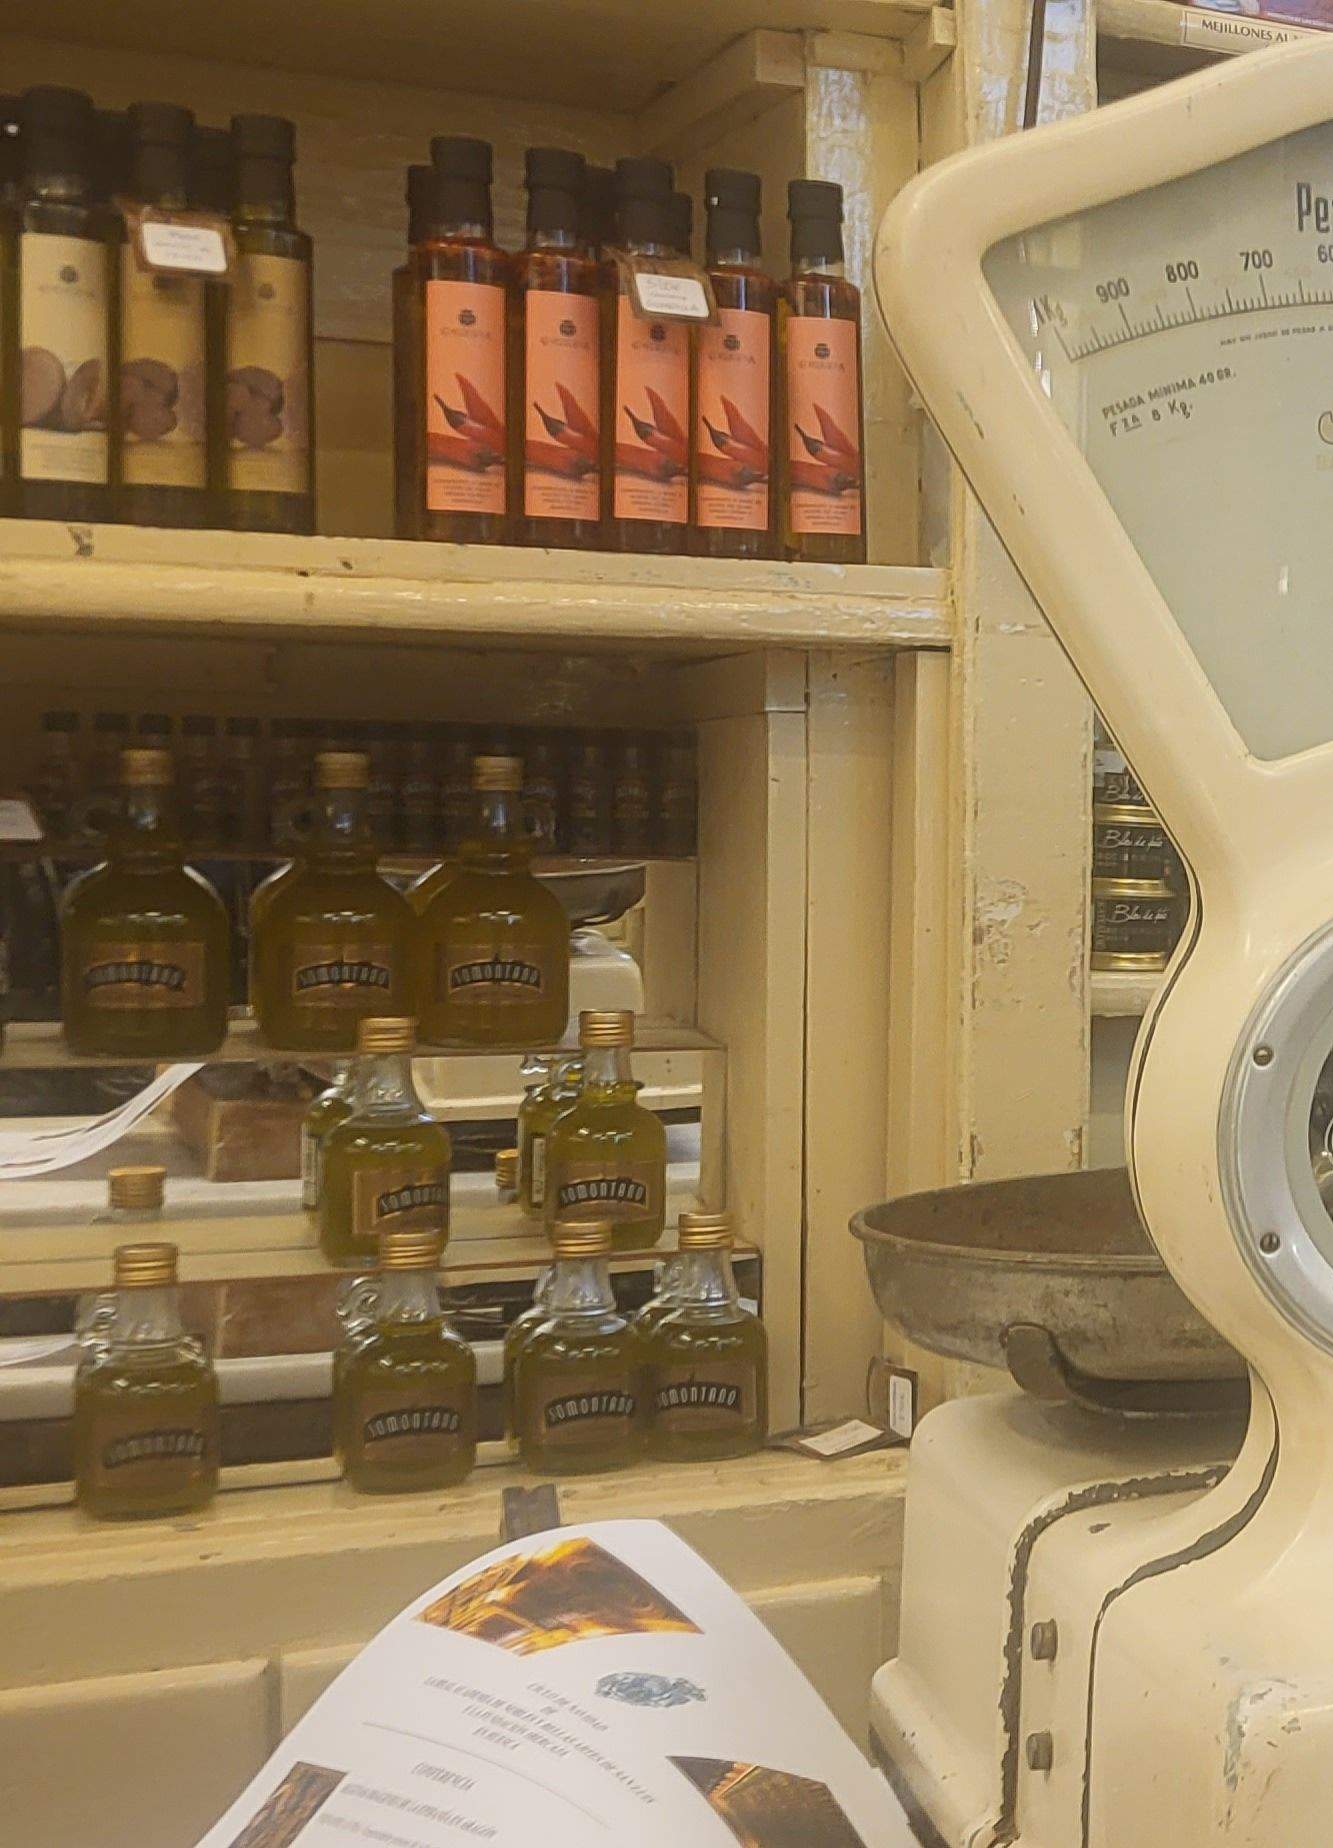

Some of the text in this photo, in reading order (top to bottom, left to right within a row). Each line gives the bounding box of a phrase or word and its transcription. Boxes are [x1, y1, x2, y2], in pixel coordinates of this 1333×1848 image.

[1201, 18, 1273, 42] MEJILLONES
[1165, 261, 1199, 283] 800
[1239, 249, 1273, 272] 700
[1096, 278, 1130, 304] 900
[1102, 394, 1146, 420] PESADA
